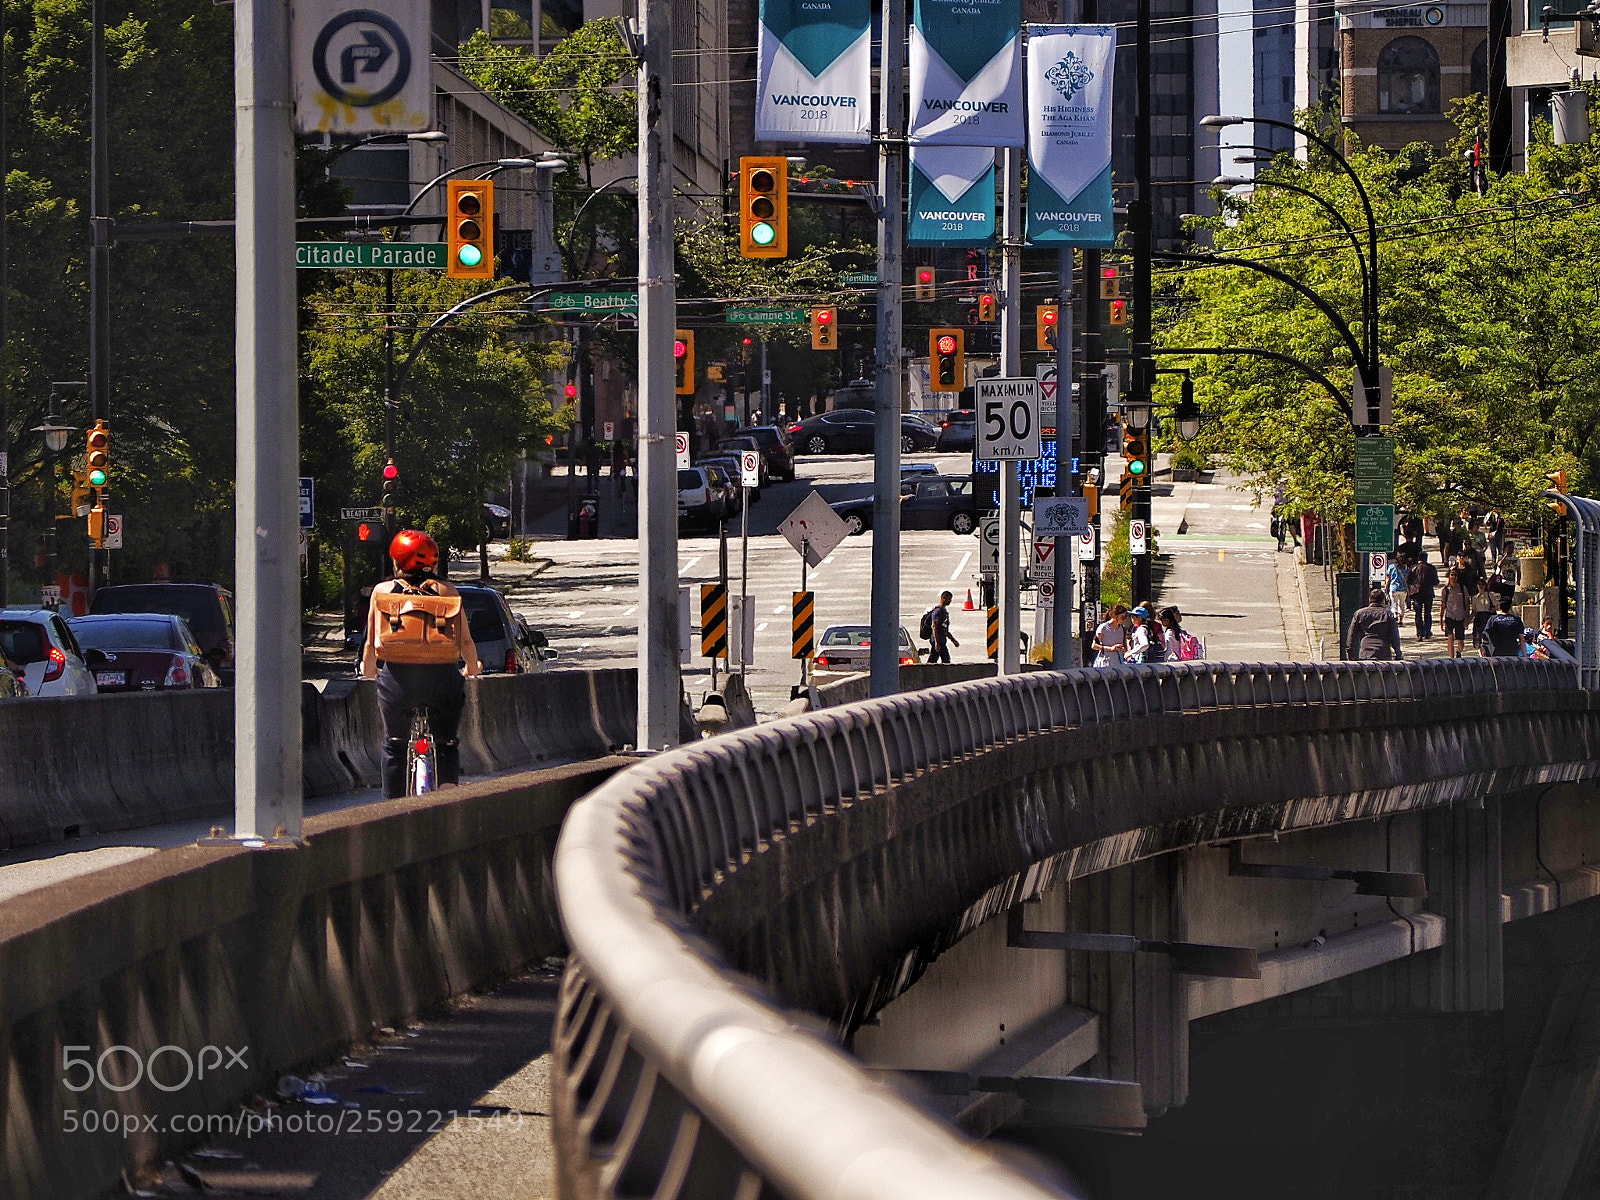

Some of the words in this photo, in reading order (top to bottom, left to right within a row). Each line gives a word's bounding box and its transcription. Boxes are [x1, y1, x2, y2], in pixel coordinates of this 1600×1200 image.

[772, 94, 857, 107] VANCOUVER
[924, 99, 1008, 113] VANCOUVER
[800, 110, 828, 120] 2018
[953, 115, 980, 125] 2018
[918, 211, 986, 222] VANCOUVER
[1035, 211, 1102, 222] VANCOUVER
[942, 222, 964, 231] 2018
[1058, 223, 1080, 232] 2018
[295, 245, 363, 264] Citadel
[371, 246, 437, 264] Parade
[584, 295, 629, 310] Beatty
[630, 294, 639, 307] S
[785, 310, 798, 320] St.
[981, 383, 1034, 397] MAXIMUM
[985, 400, 1031, 441] 50
[992, 445, 1025, 456] km/h
[345, 509, 369, 518] BEATTY
